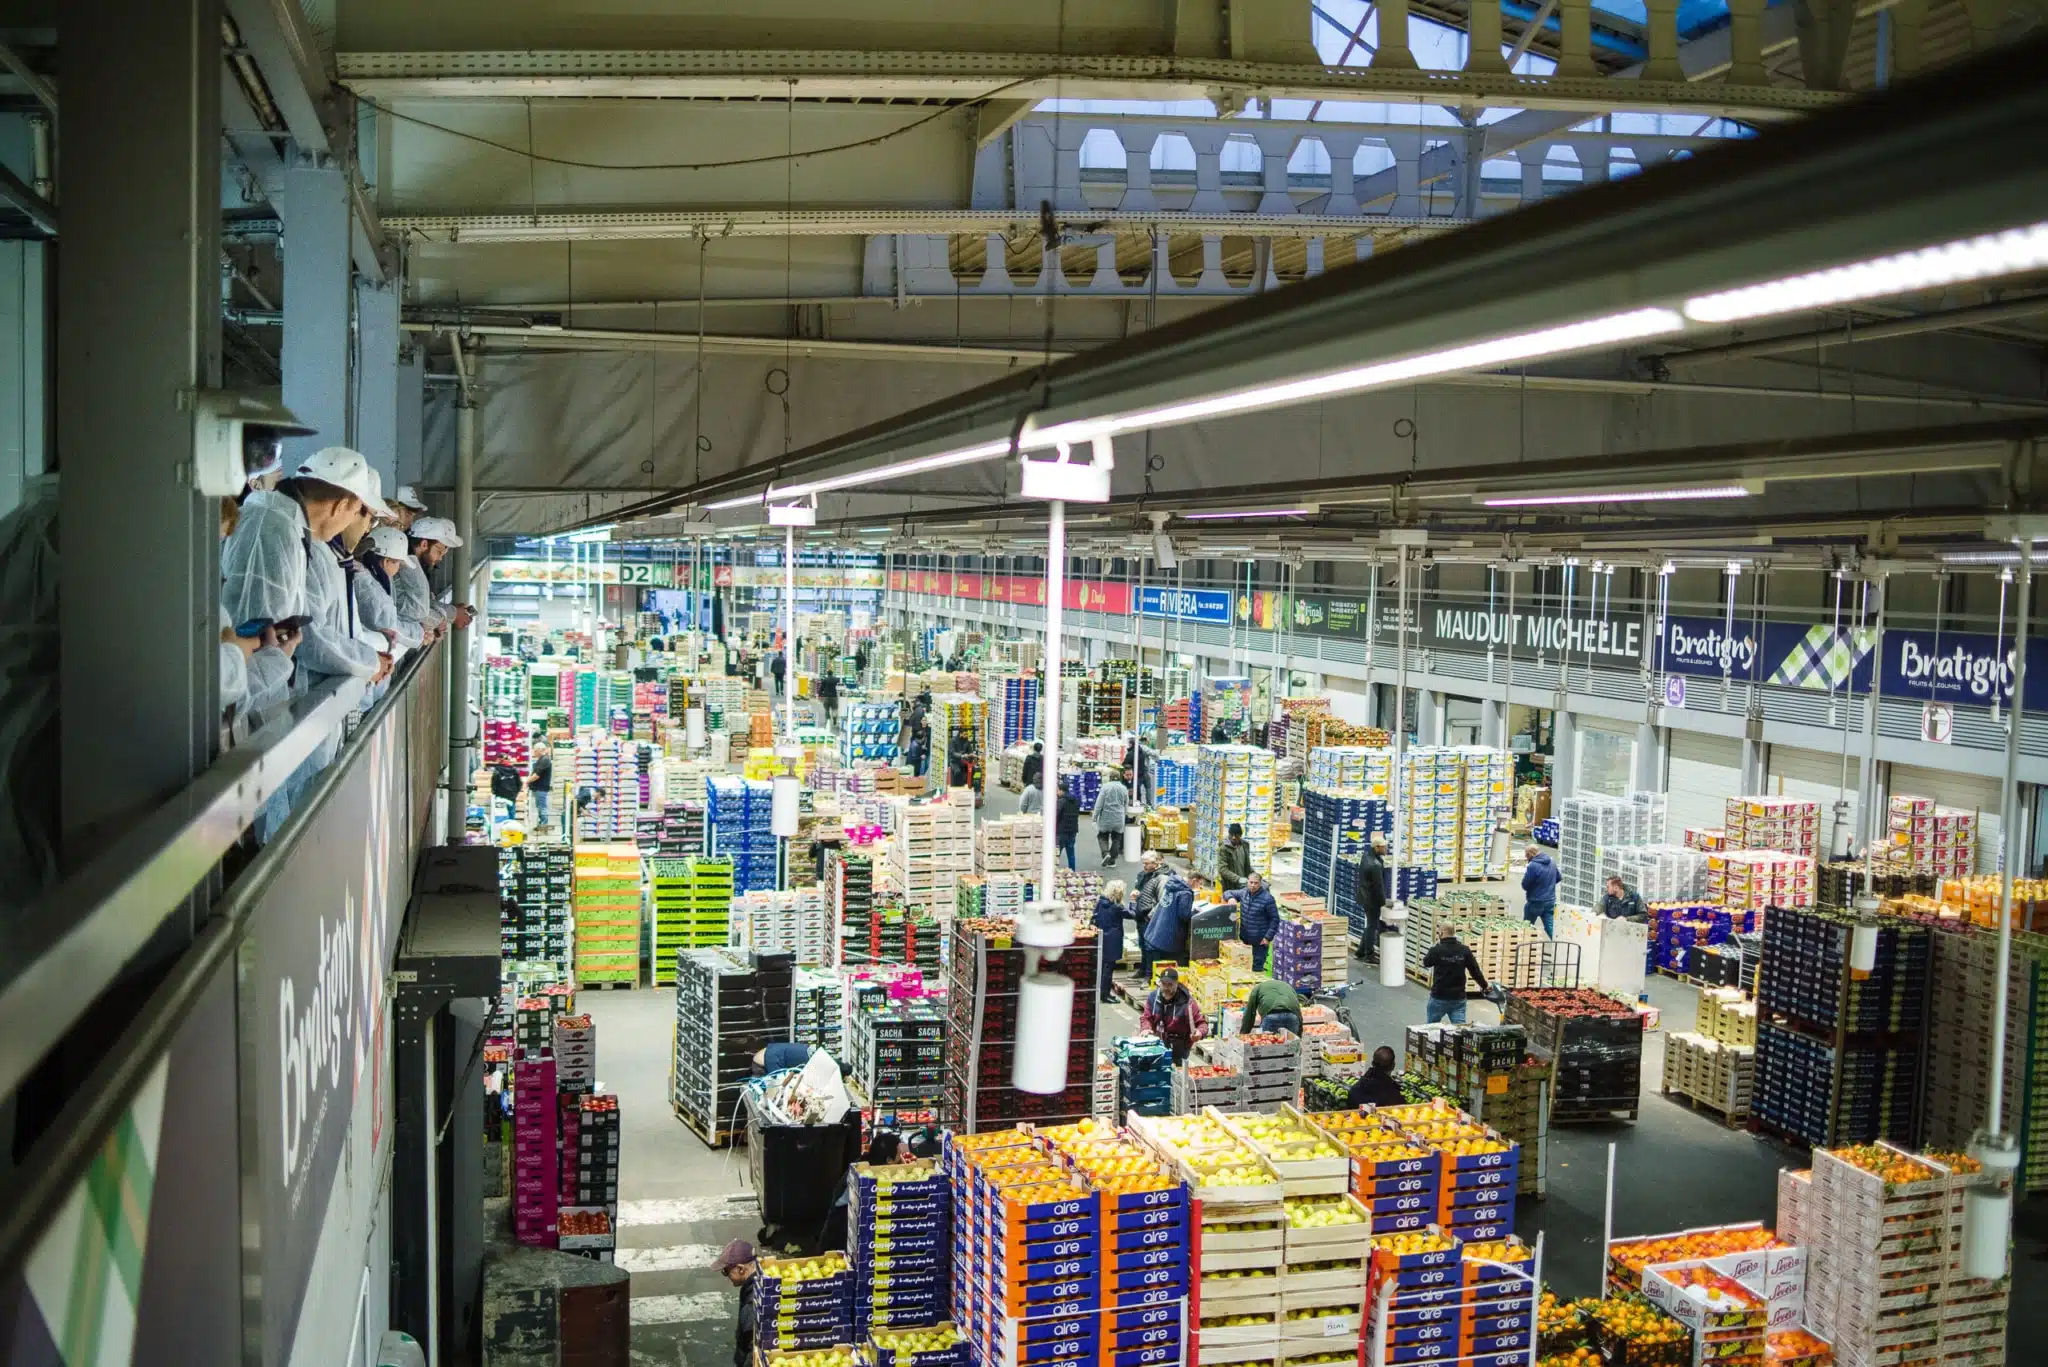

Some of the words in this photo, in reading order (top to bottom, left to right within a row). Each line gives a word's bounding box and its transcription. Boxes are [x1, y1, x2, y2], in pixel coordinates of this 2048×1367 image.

[620, 565, 649, 583] D2
[1159, 591, 1198, 615] RIVIERA
[1435, 608, 1522, 645] MAUDUIT
[1526, 614, 1641, 657] MICHELLE
[1671, 623, 1758, 670] Bratigny
[1900, 639, 2026, 697] Bratigny
[1908, 679, 1928, 688] FRUITS
[549, 855, 569, 864] SACHA
[526, 861, 546, 869] SACHA
[526, 877, 546, 885] SACHA
[526, 893, 546, 901] SACHA
[550, 893, 570, 901] SACHA
[526, 909, 546, 917] SACHA
[1193, 926, 1234, 936] CHAMPARIS
[501, 942, 518, 950] ACHA
[862, 994, 885, 1004] SACHA
[279, 880, 355, 1188] Bratigny
[879, 1028, 903, 1038] SACHA
[917, 1027, 941, 1037] SACHA
[1491, 1040, 1516, 1050] SACHA
[879, 1048, 902, 1058] SACHA
[917, 1046, 940, 1057] SACHA
[1491, 1057, 1516, 1067] SACHA
